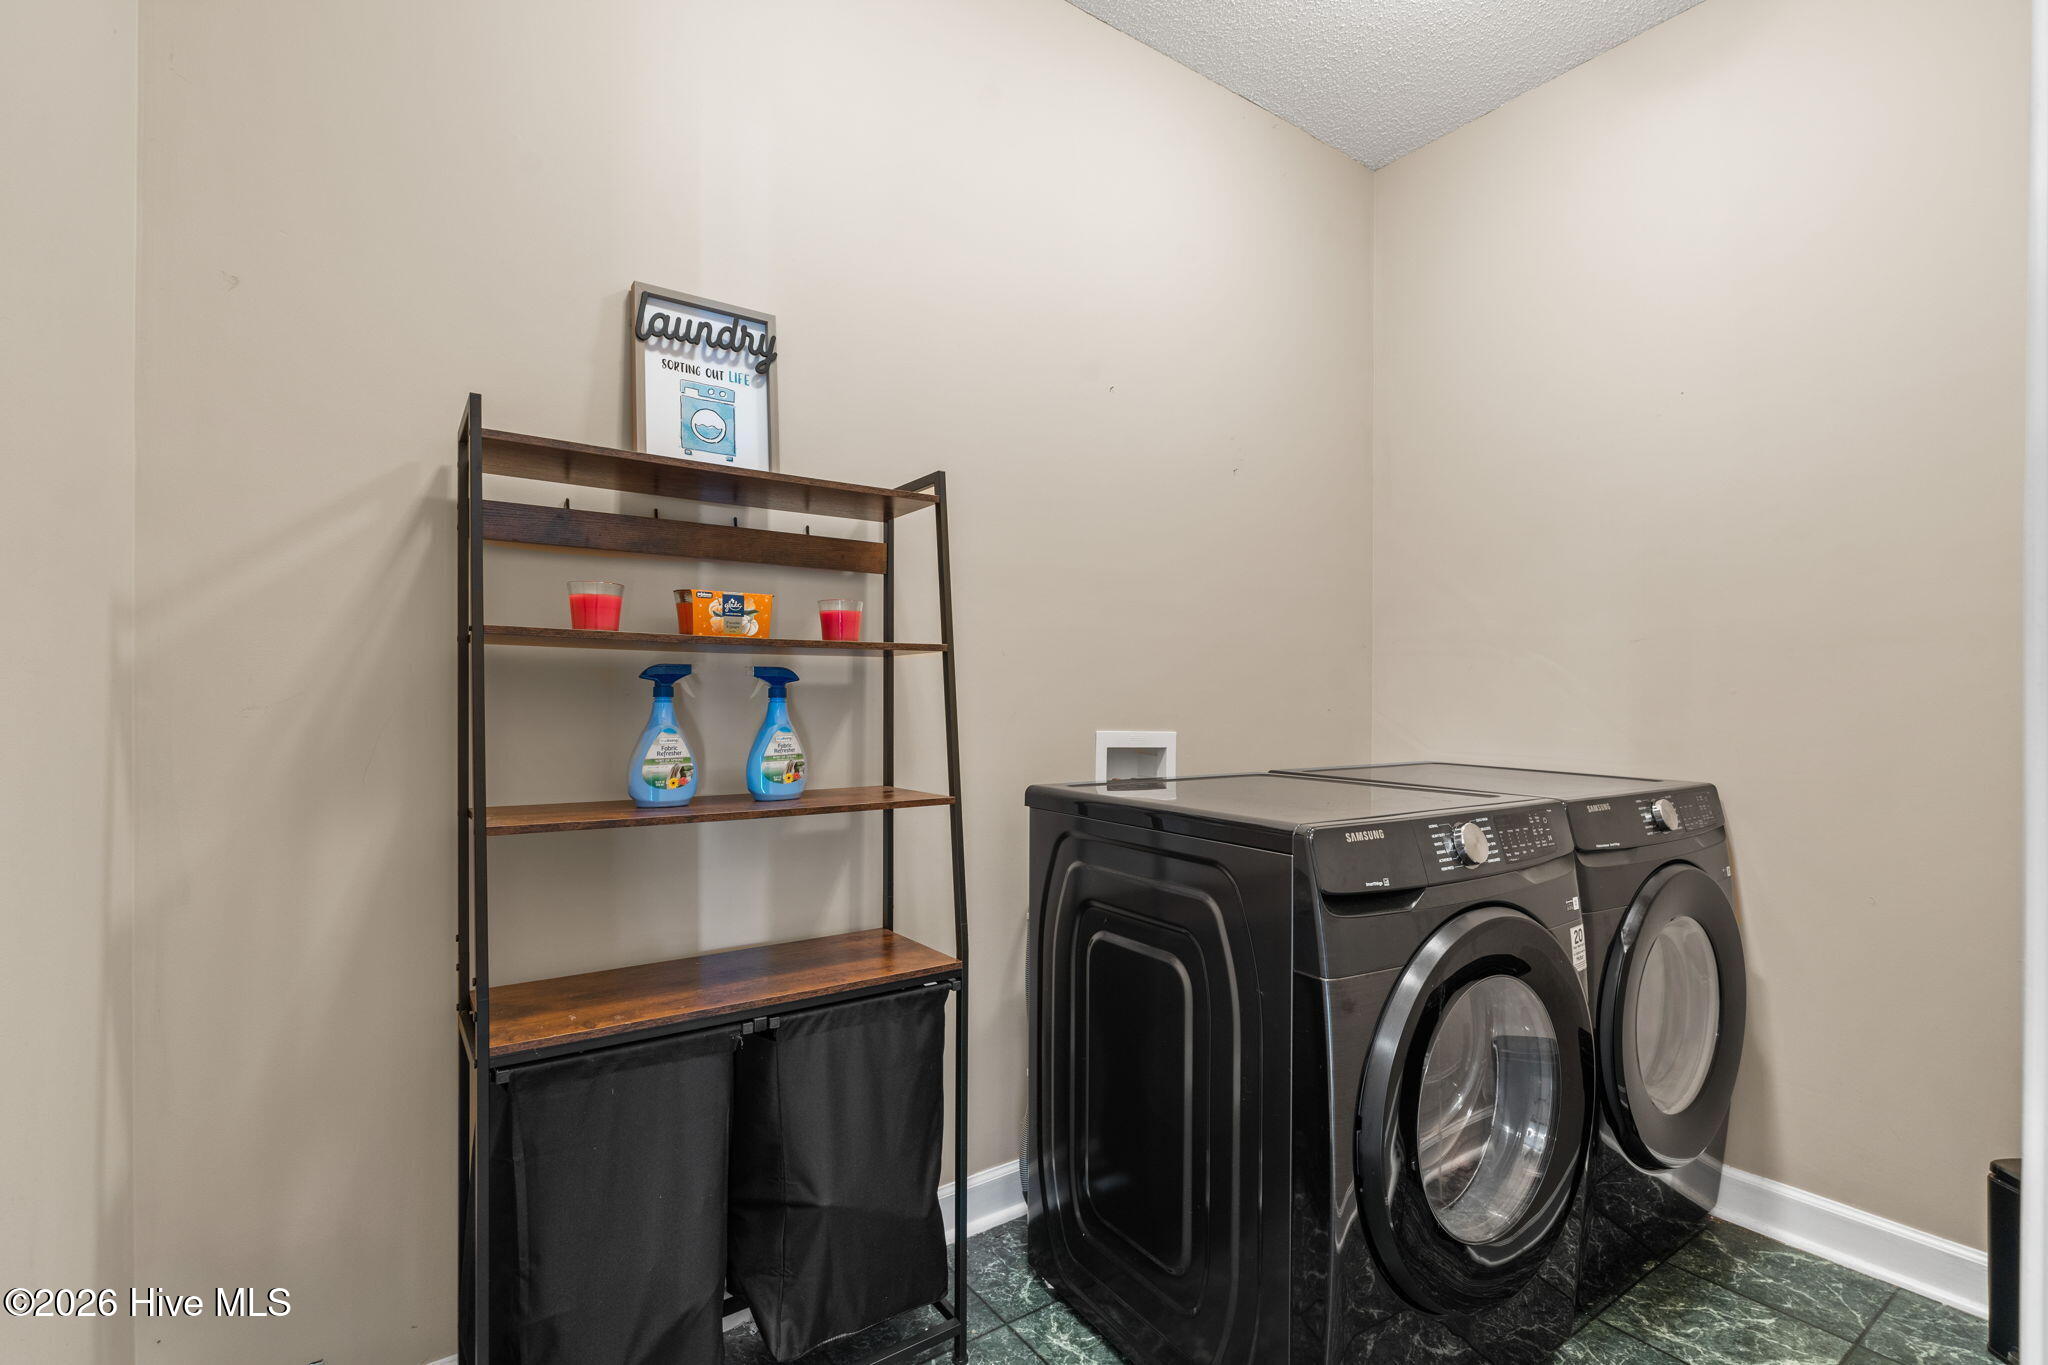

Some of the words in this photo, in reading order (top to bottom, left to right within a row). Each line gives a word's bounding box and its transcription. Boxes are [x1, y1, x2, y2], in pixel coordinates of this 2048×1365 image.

[635, 291, 778, 375] laundry
[661, 358, 701, 376] SORTING
[706, 367, 724, 381] OUT
[728, 370, 750, 386] LIFE
[656, 750, 683, 758] Refresher
[1586, 802, 1612, 813] SAMSUNG
[1344, 828, 1385, 843] SAMSUNG
[1573, 928, 1584, 945] 20
